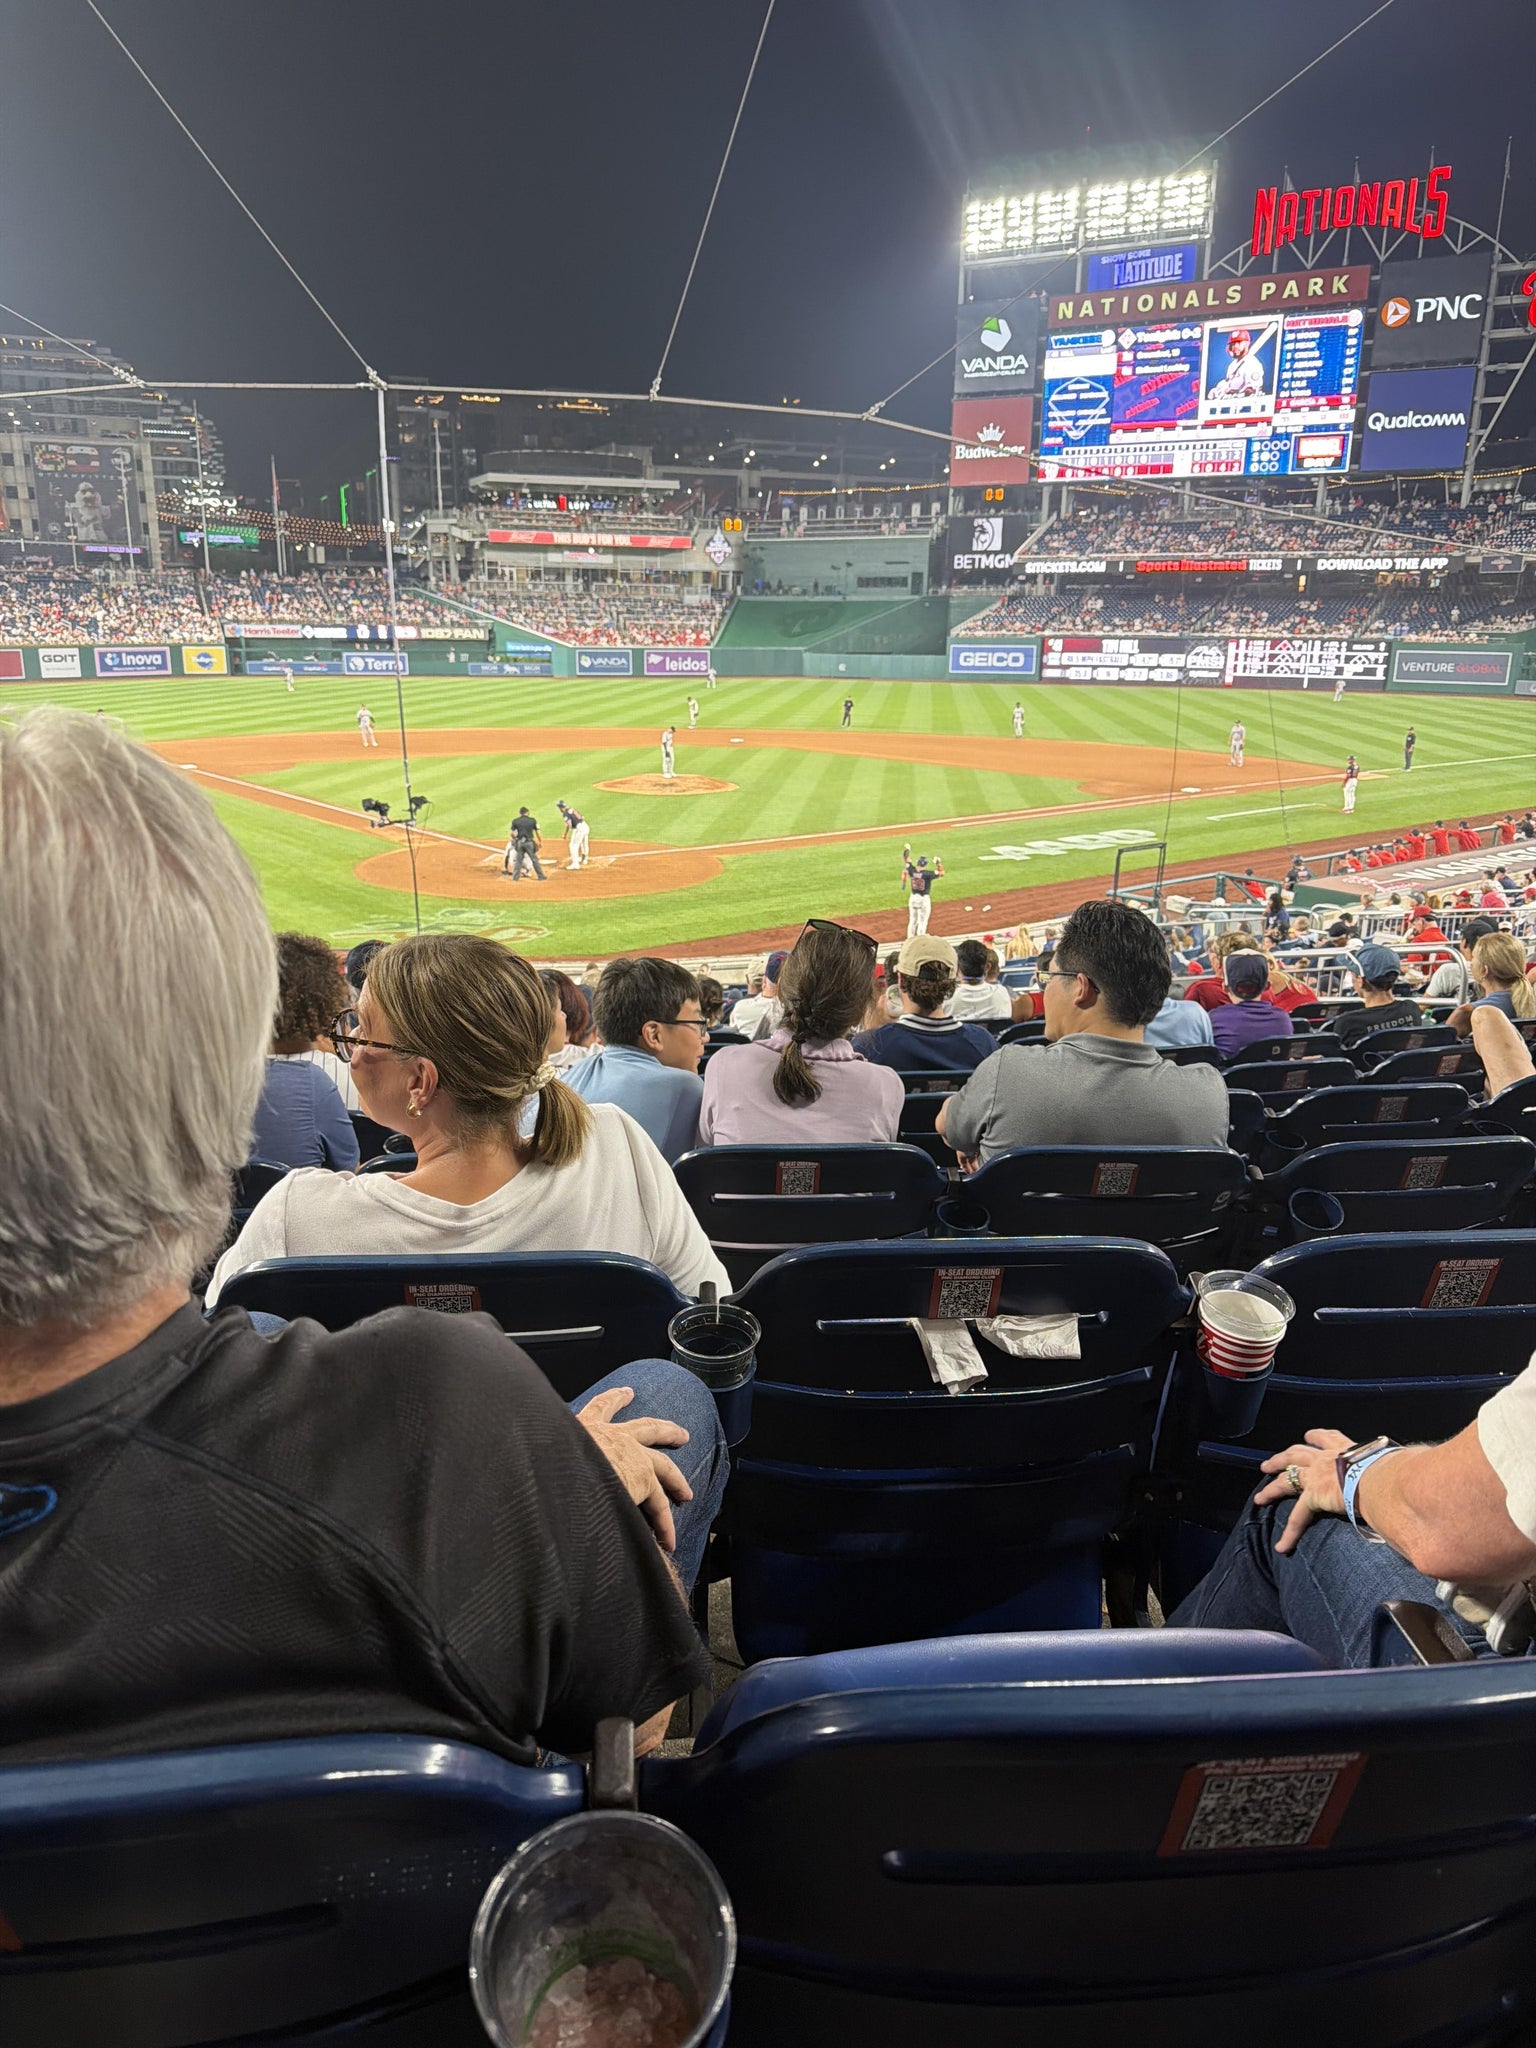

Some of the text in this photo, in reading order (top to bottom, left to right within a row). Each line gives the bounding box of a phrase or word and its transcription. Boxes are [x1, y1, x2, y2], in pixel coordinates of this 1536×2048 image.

[1252, 166, 1452, 256] NATIONALS
[1101, 249, 1151, 264] SHOW SOME
[1114, 252, 1183, 285] NATITUDE
[1057, 274, 1351, 320] NATIONALS PARK
[1415, 294, 1483, 322] PNC
[961, 354, 1029, 373] VANDA
[1368, 410, 1466, 432] Qualcomm
[1136, 560, 1180, 573] Sports
[1249, 559, 1283, 570] TICKETS
[1317, 557, 1449, 571] DOWNLOAD THE APP
[244, 626, 300, 636] Harris Teeter
[42, 654, 77, 663] GDIT
[122, 652, 162, 666] Inova
[365, 658, 404, 672] Terra
[592, 658, 628, 666] VANDA
[666, 656, 707, 671] leidos
[959, 652, 1025, 668] GEICO
[1402, 662, 1503, 675] VENTURE GLOBAL
[1367, 1015, 1413, 1032] FREEDOM
[1440, 1260, 1464, 1268] IN-SEAT
[938, 1268, 1000, 1276] IN-SEAT ORDERING
[408, 1285, 437, 1293] IN-SEAT
